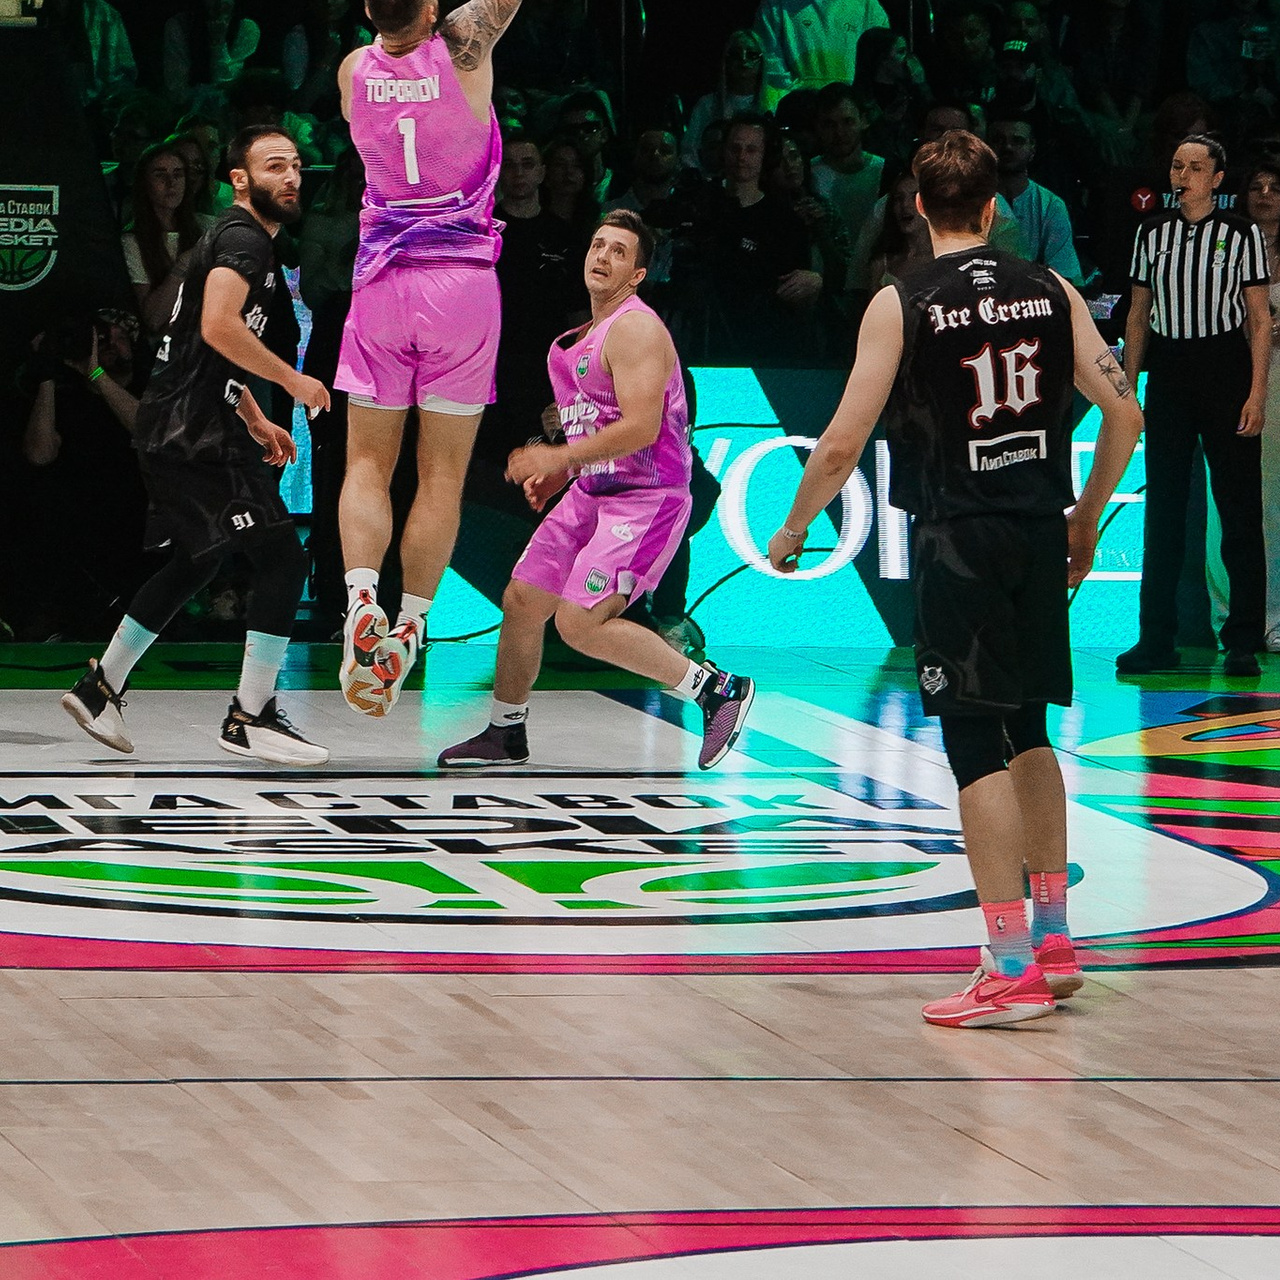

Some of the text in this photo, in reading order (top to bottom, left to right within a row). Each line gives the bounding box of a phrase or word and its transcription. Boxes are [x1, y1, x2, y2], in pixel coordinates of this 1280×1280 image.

[398, 118, 420, 184] 1
[928, 296, 1053, 334] Ice Cream
[960, 337, 1041, 429] 16
[231, 511, 255, 530] 91
